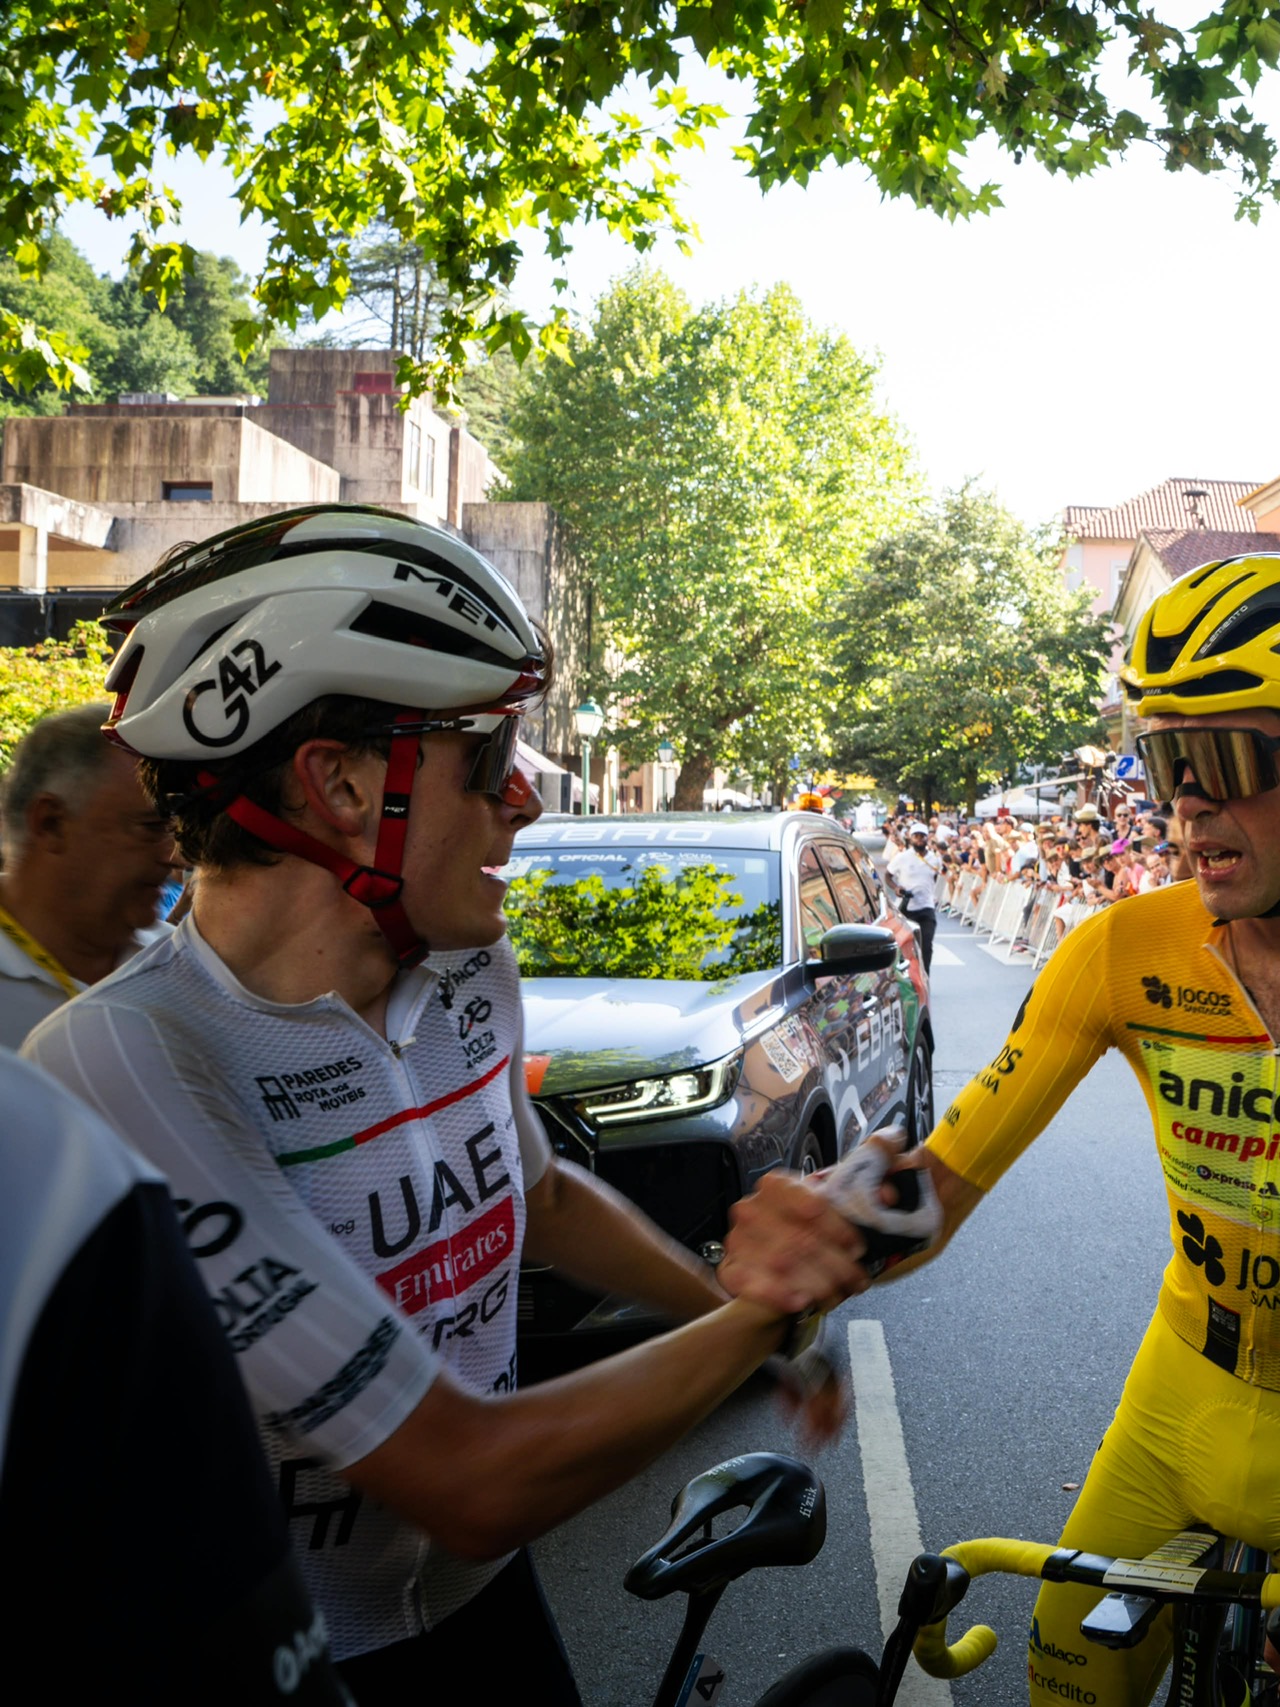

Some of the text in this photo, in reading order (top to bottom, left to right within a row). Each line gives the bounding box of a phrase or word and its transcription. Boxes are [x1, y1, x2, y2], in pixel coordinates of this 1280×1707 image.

[393, 562, 508, 632] MET
[508, 853, 628, 863] TURA OFICIAL
[1177, 985, 1232, 1007] JOGOS
[281, 1055, 364, 1090] PAREDES
[293, 1086, 332, 1104] ROTA
[368, 1121, 511, 1259] UAE
[395, 1222, 508, 1308] Emirates
